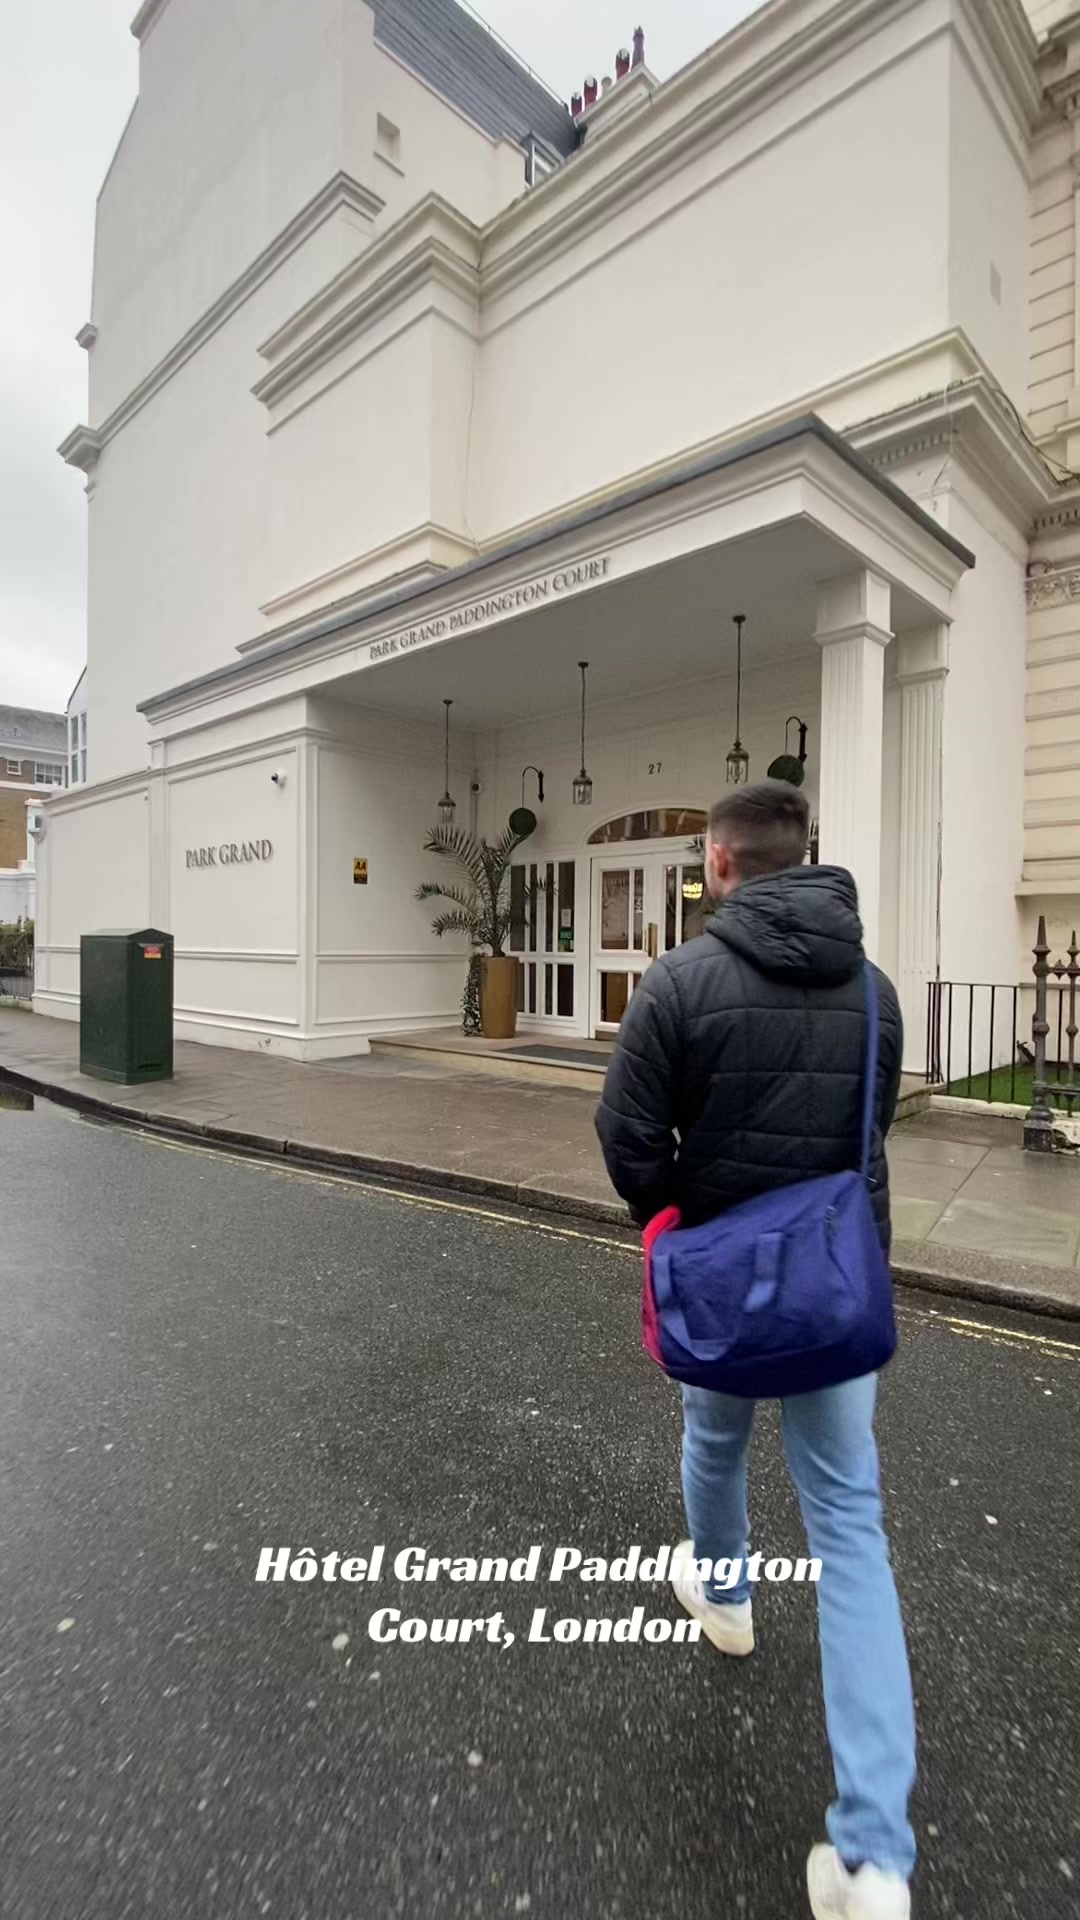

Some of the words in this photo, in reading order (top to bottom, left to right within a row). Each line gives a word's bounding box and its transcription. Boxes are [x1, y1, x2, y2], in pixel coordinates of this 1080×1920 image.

[369, 639, 398, 659] PARK
[400, 620, 446, 648] GRAND
[449, 580, 548, 630] PADDINGTON
[552, 556, 611, 592] COURT
[648, 762, 662, 775] 27
[185, 846, 217, 868] PARK
[218, 839, 273, 865] GRAND
